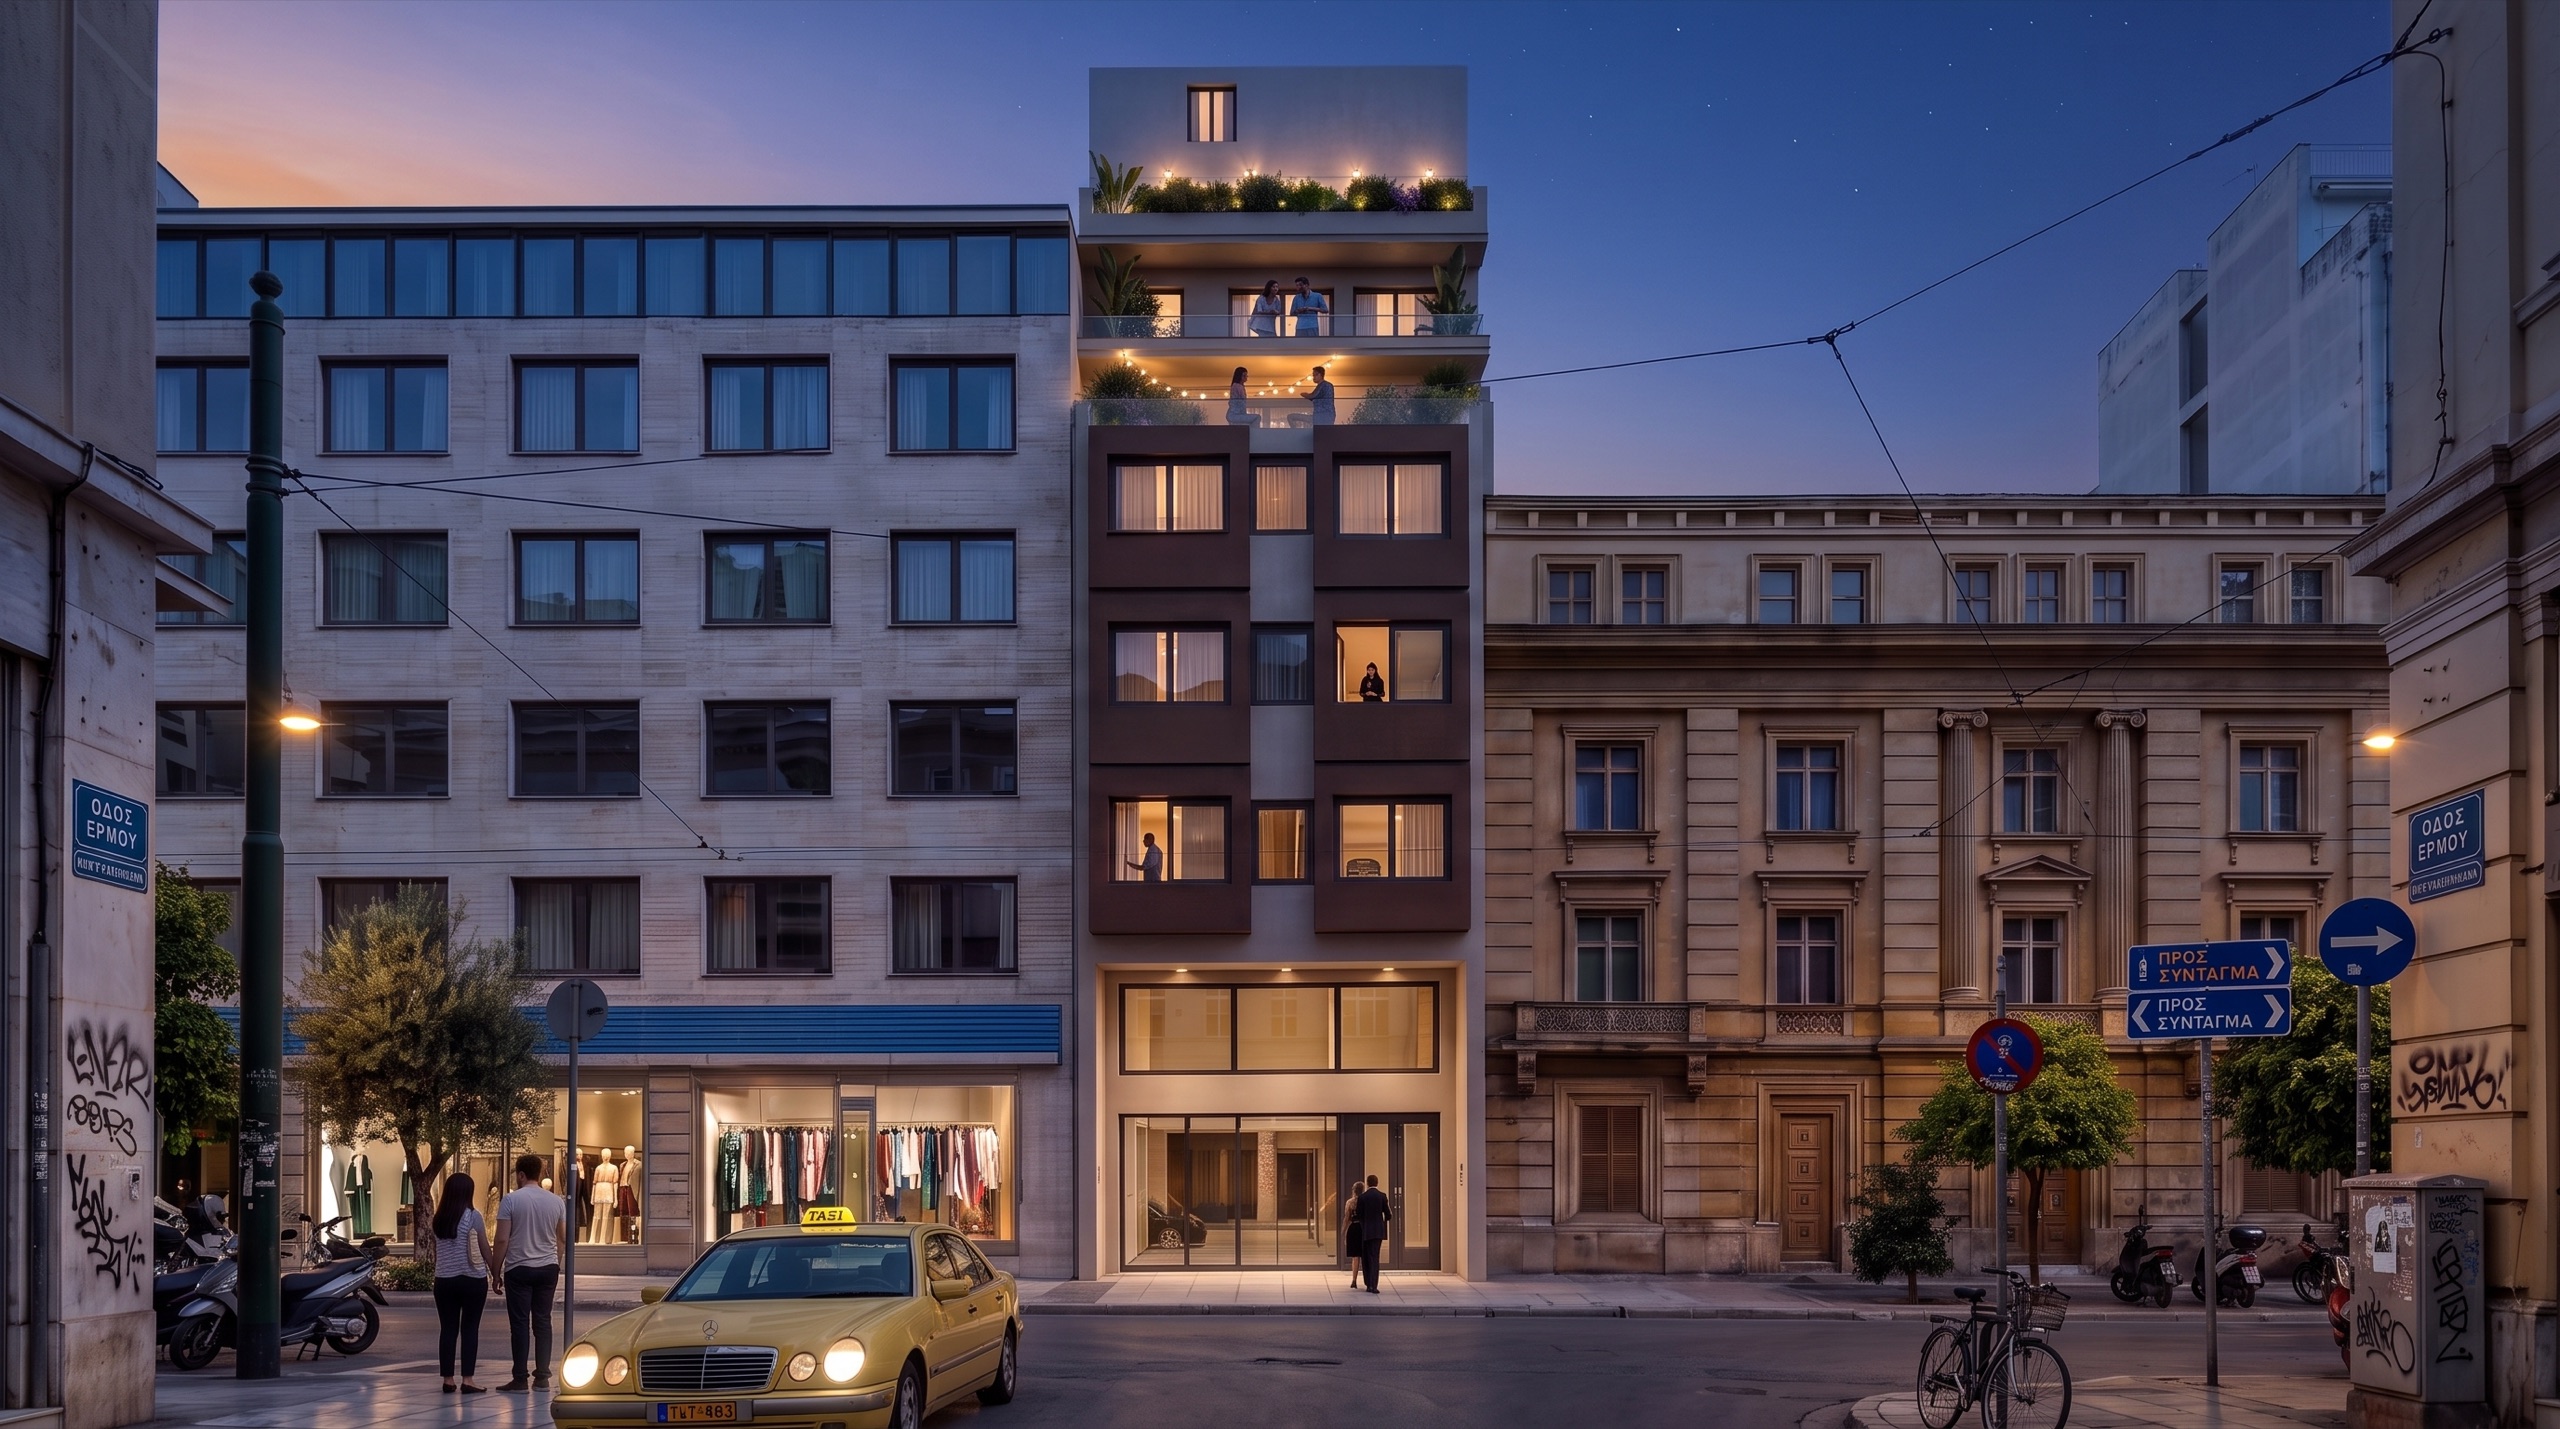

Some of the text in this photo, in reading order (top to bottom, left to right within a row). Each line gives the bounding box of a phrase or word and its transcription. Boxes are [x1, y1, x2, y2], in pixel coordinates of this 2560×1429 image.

[91, 798, 133, 826] ΟΔΟΣ
[2422, 807, 2464, 836] ΟΔΟΣ
[86, 820, 137, 849] ΕΡΜΟΥ
[2418, 830, 2468, 861] ΕΡΜΟΥ
[2159, 950, 2208, 965] ΠΡΟΣ
[2159, 965, 2259, 983] ΣΥΝΤΑΓΜΑ
[2158, 997, 2207, 1012] ΠΡΟΣ
[2158, 1014, 2253, 1031] ΣΥΝΤΑΓΜΑ
[808, 1210, 844, 1221] TASI
